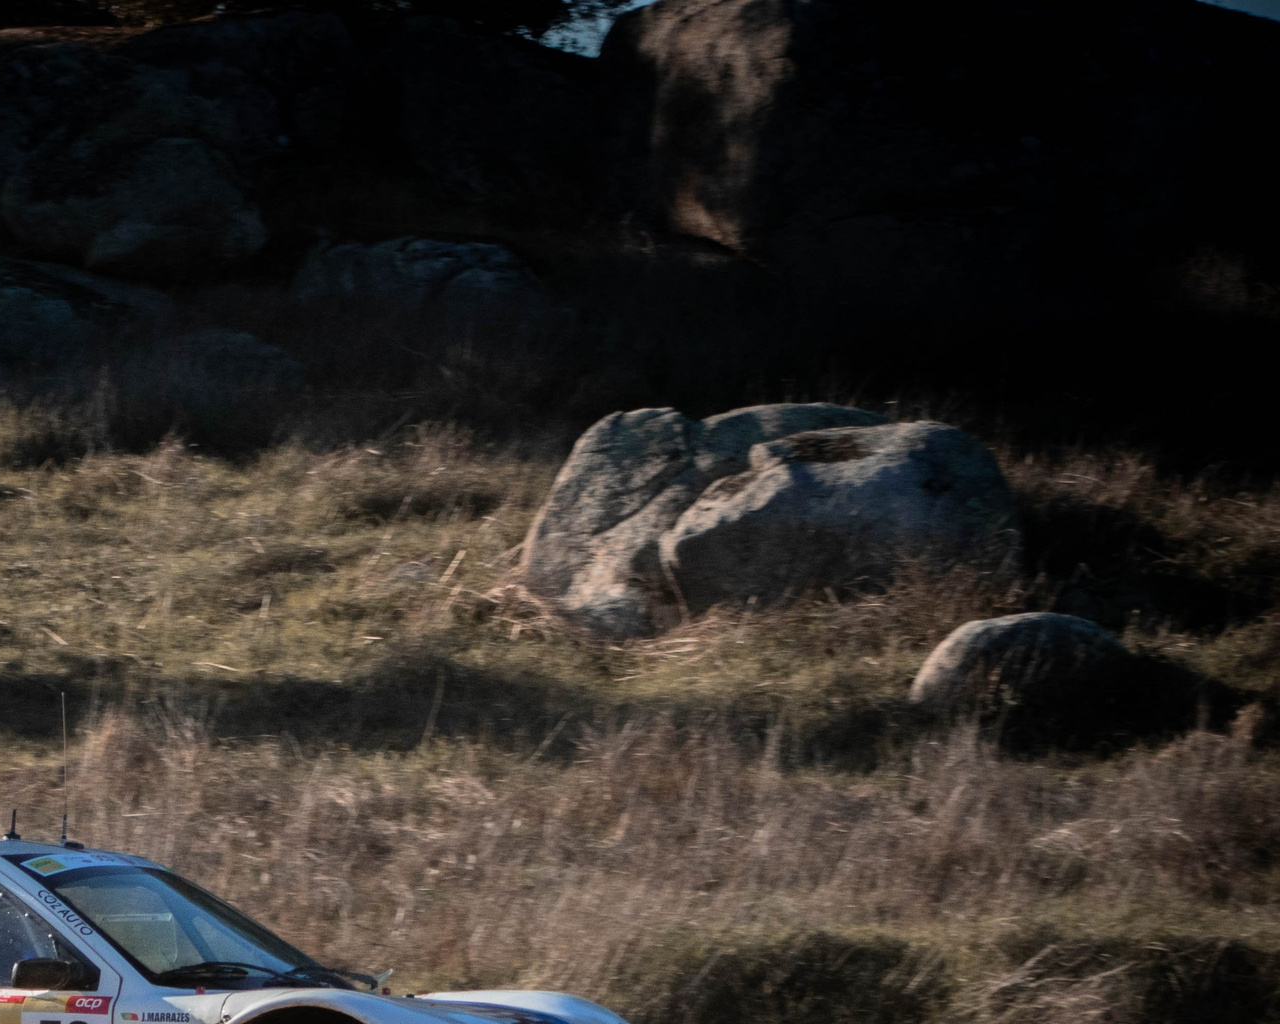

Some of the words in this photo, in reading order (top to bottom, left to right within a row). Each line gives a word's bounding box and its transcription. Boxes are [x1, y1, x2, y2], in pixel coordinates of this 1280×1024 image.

[58, 909, 93, 936] AUTO
[75, 998, 103, 1009] acp
[141, 1012, 190, 1022] J.MARRAZES
